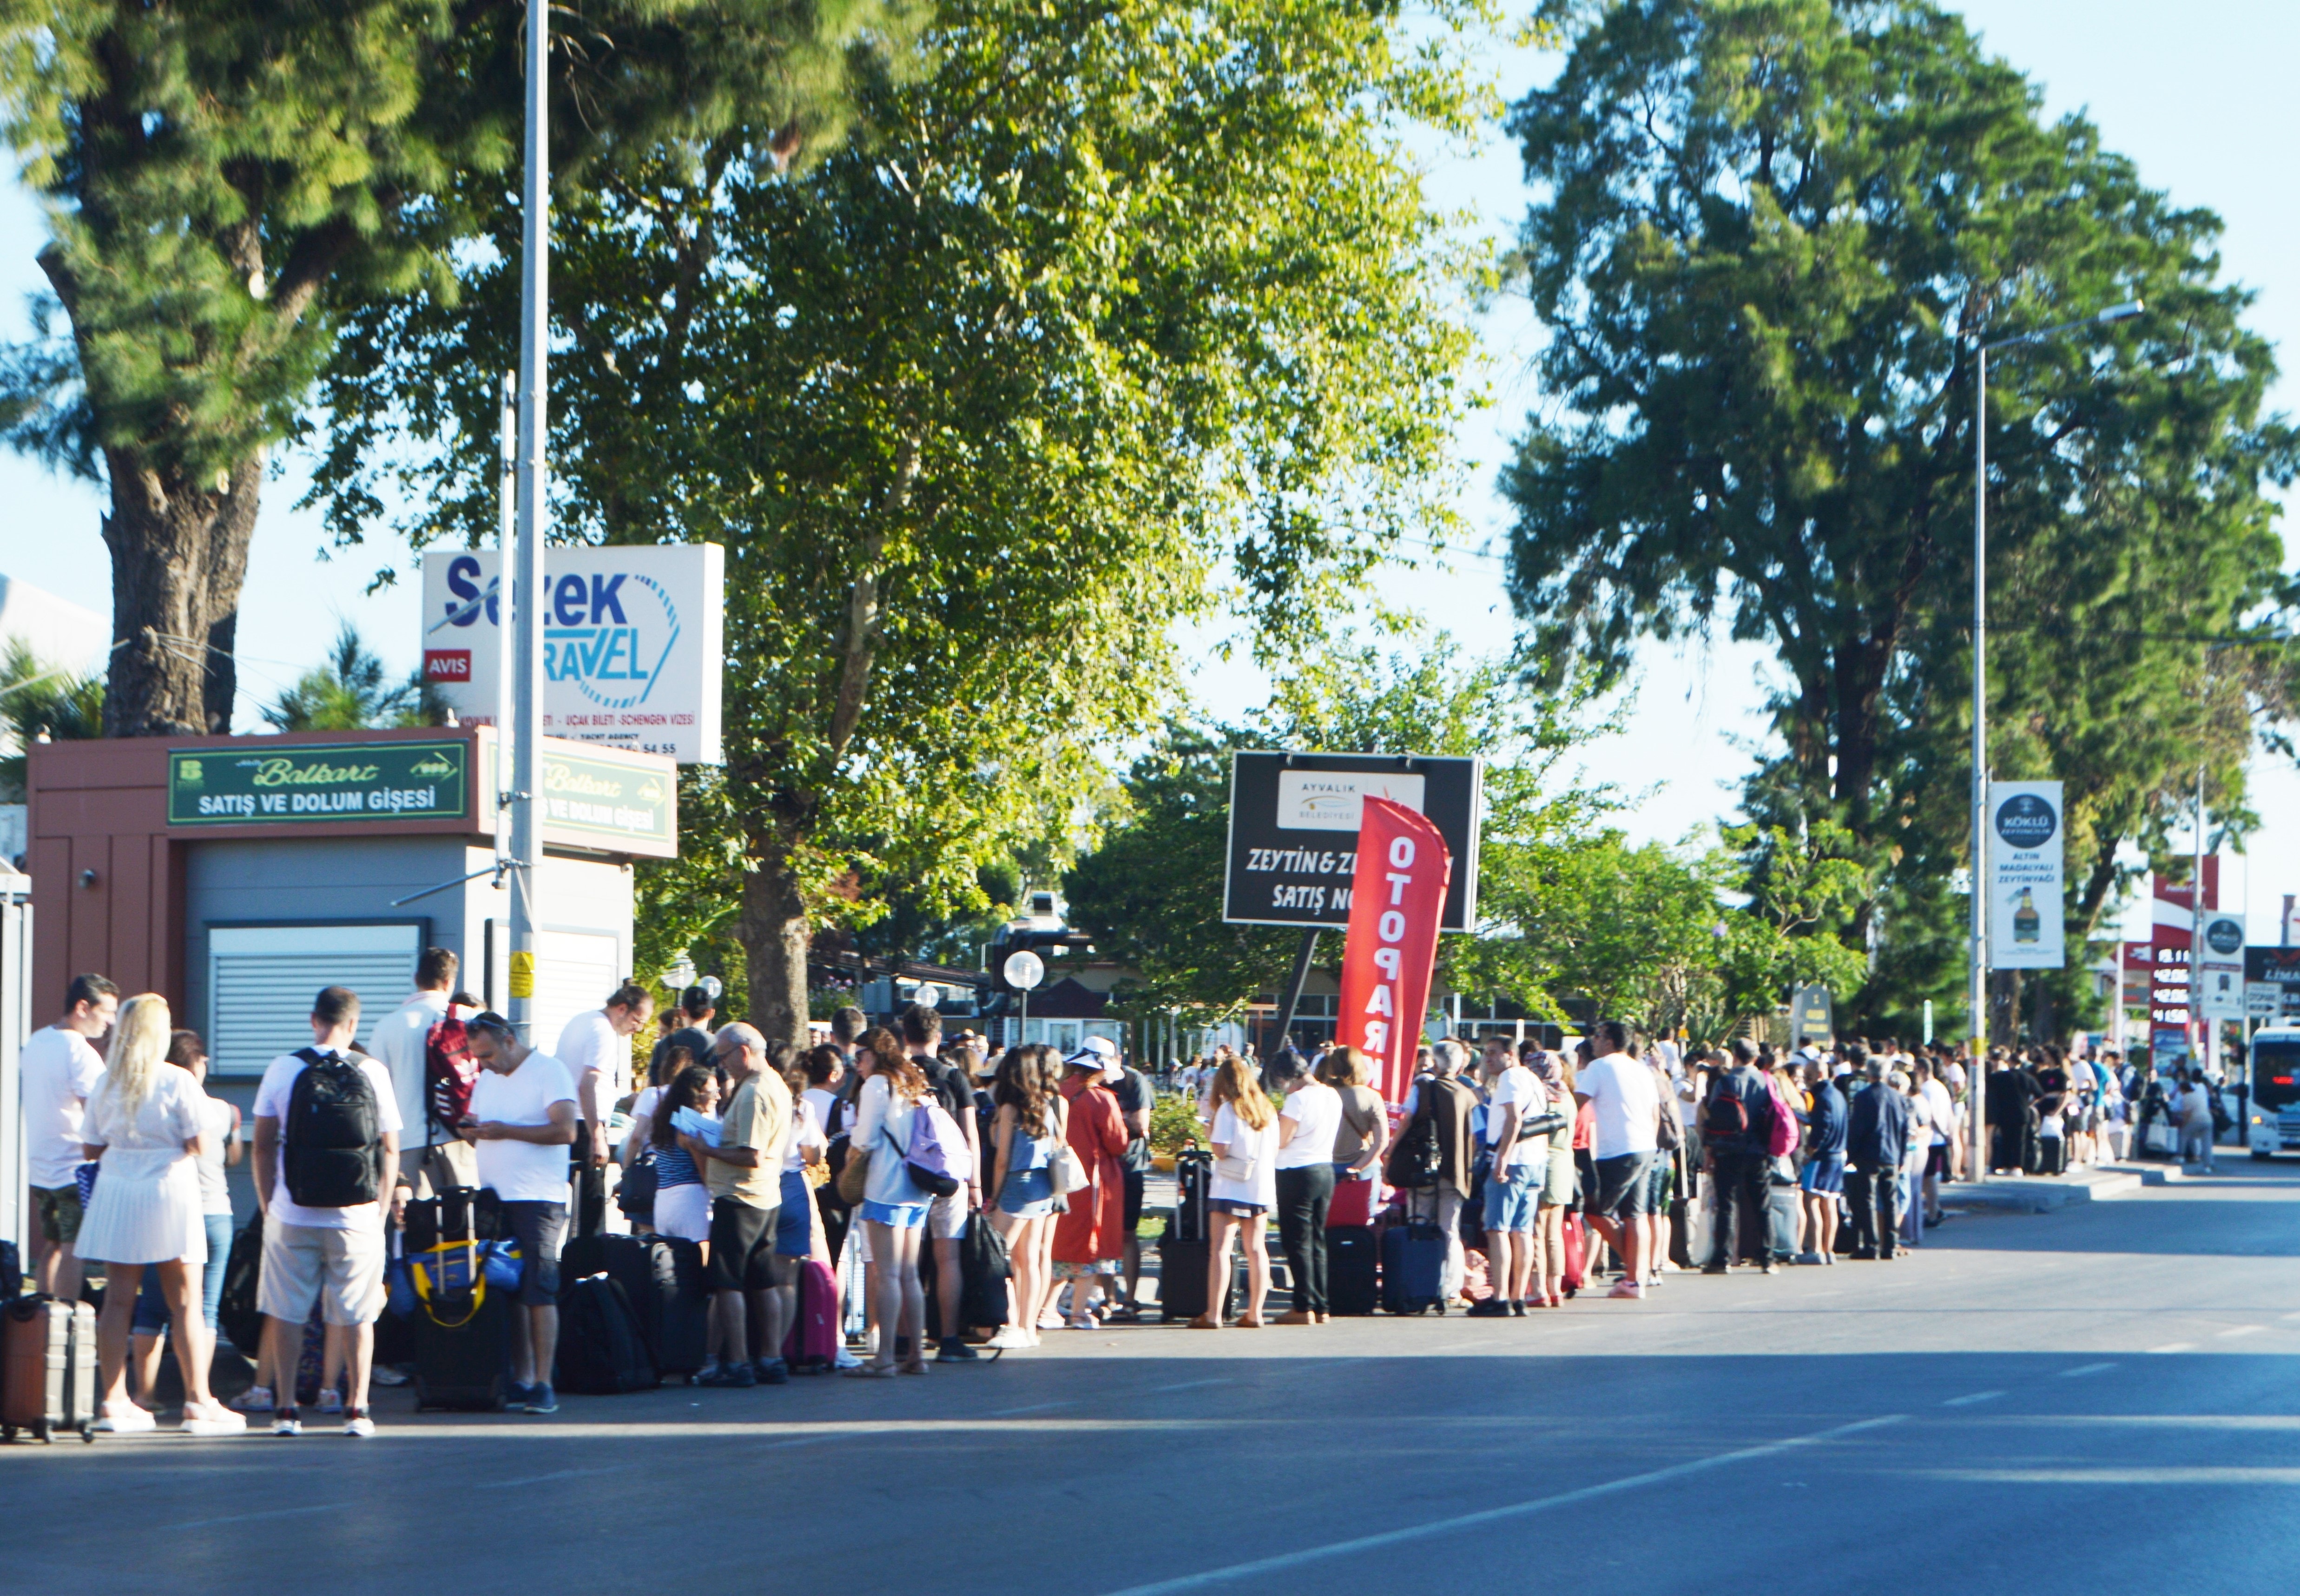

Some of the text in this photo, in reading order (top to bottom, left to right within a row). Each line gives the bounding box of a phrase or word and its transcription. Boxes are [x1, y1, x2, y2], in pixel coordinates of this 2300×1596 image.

[428, 658, 467, 673] AVIS
[566, 715, 589, 729] UÇAK
[643, 743, 657, 754] 54
[662, 743, 676, 754] 55
[253, 758, 380, 787] Balkart
[1301, 782, 1356, 793] AYVALIK
[198, 784, 436, 817] SATIŞ VE DOLUM GİŞESİ
[2003, 815, 2050, 828] KÖKLÜ
[1998, 873, 2055, 883] ZEYTİNYAĞI
[1272, 883, 1326, 916] SATIŞ
